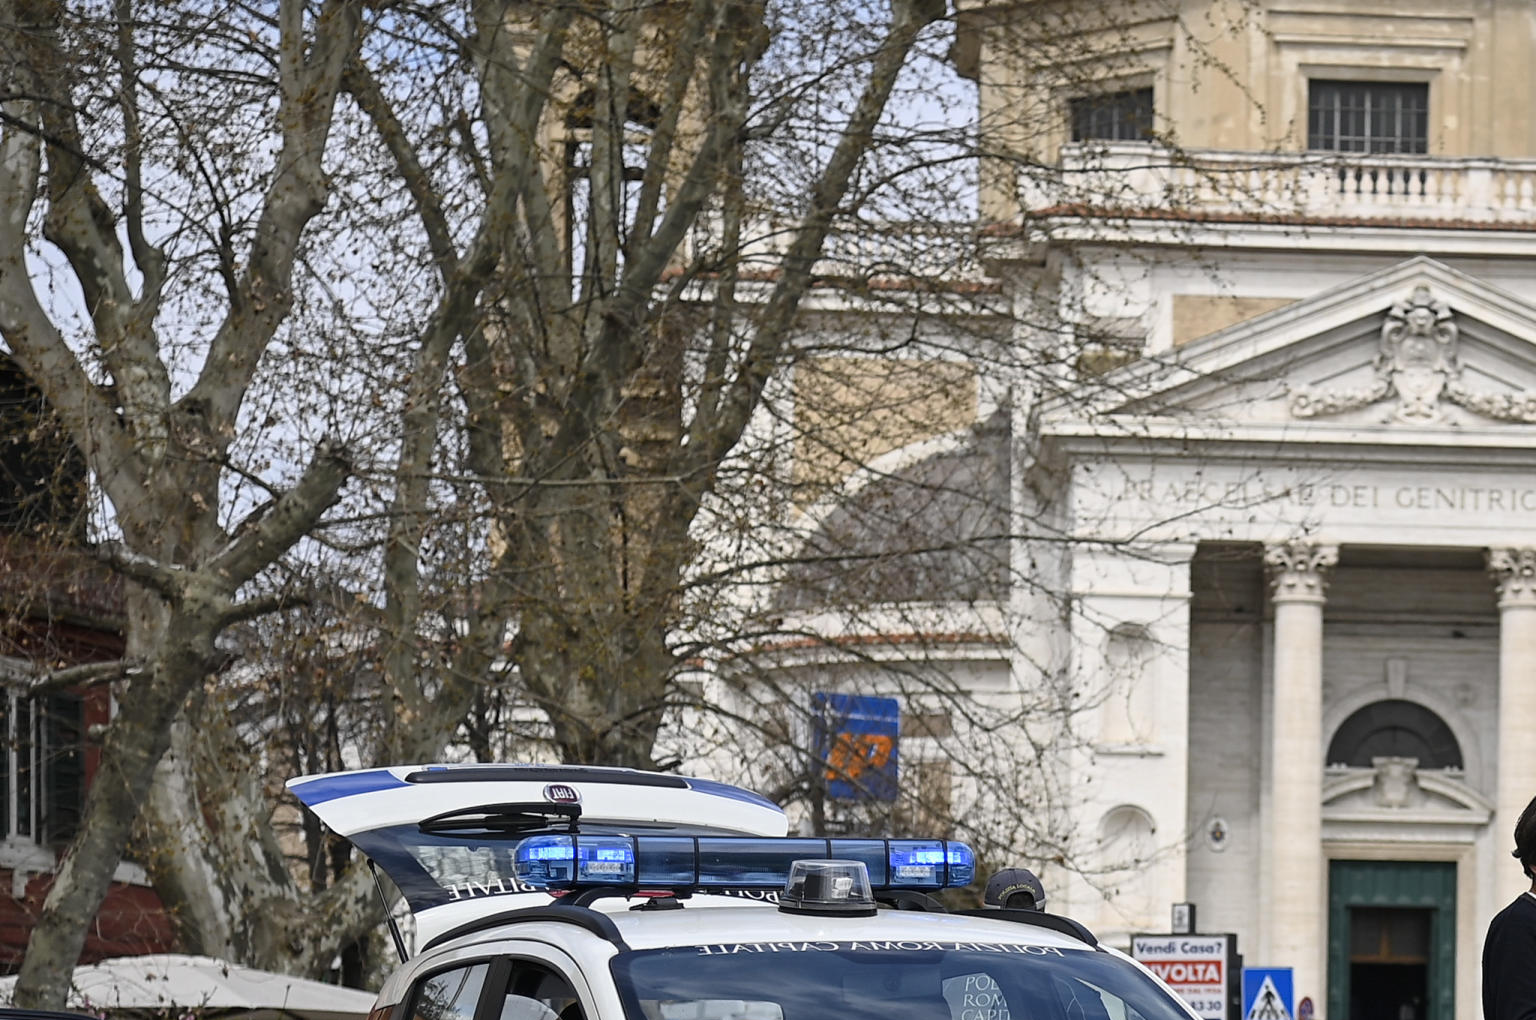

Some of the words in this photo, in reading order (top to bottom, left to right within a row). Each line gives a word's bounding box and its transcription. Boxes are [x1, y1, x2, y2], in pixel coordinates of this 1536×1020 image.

[1331, 484, 1379, 509] DEI
[1136, 942, 1176, 954] Vendi
[1181, 942, 1223, 954] Casa?
[1150, 963, 1221, 982] VOLTA
